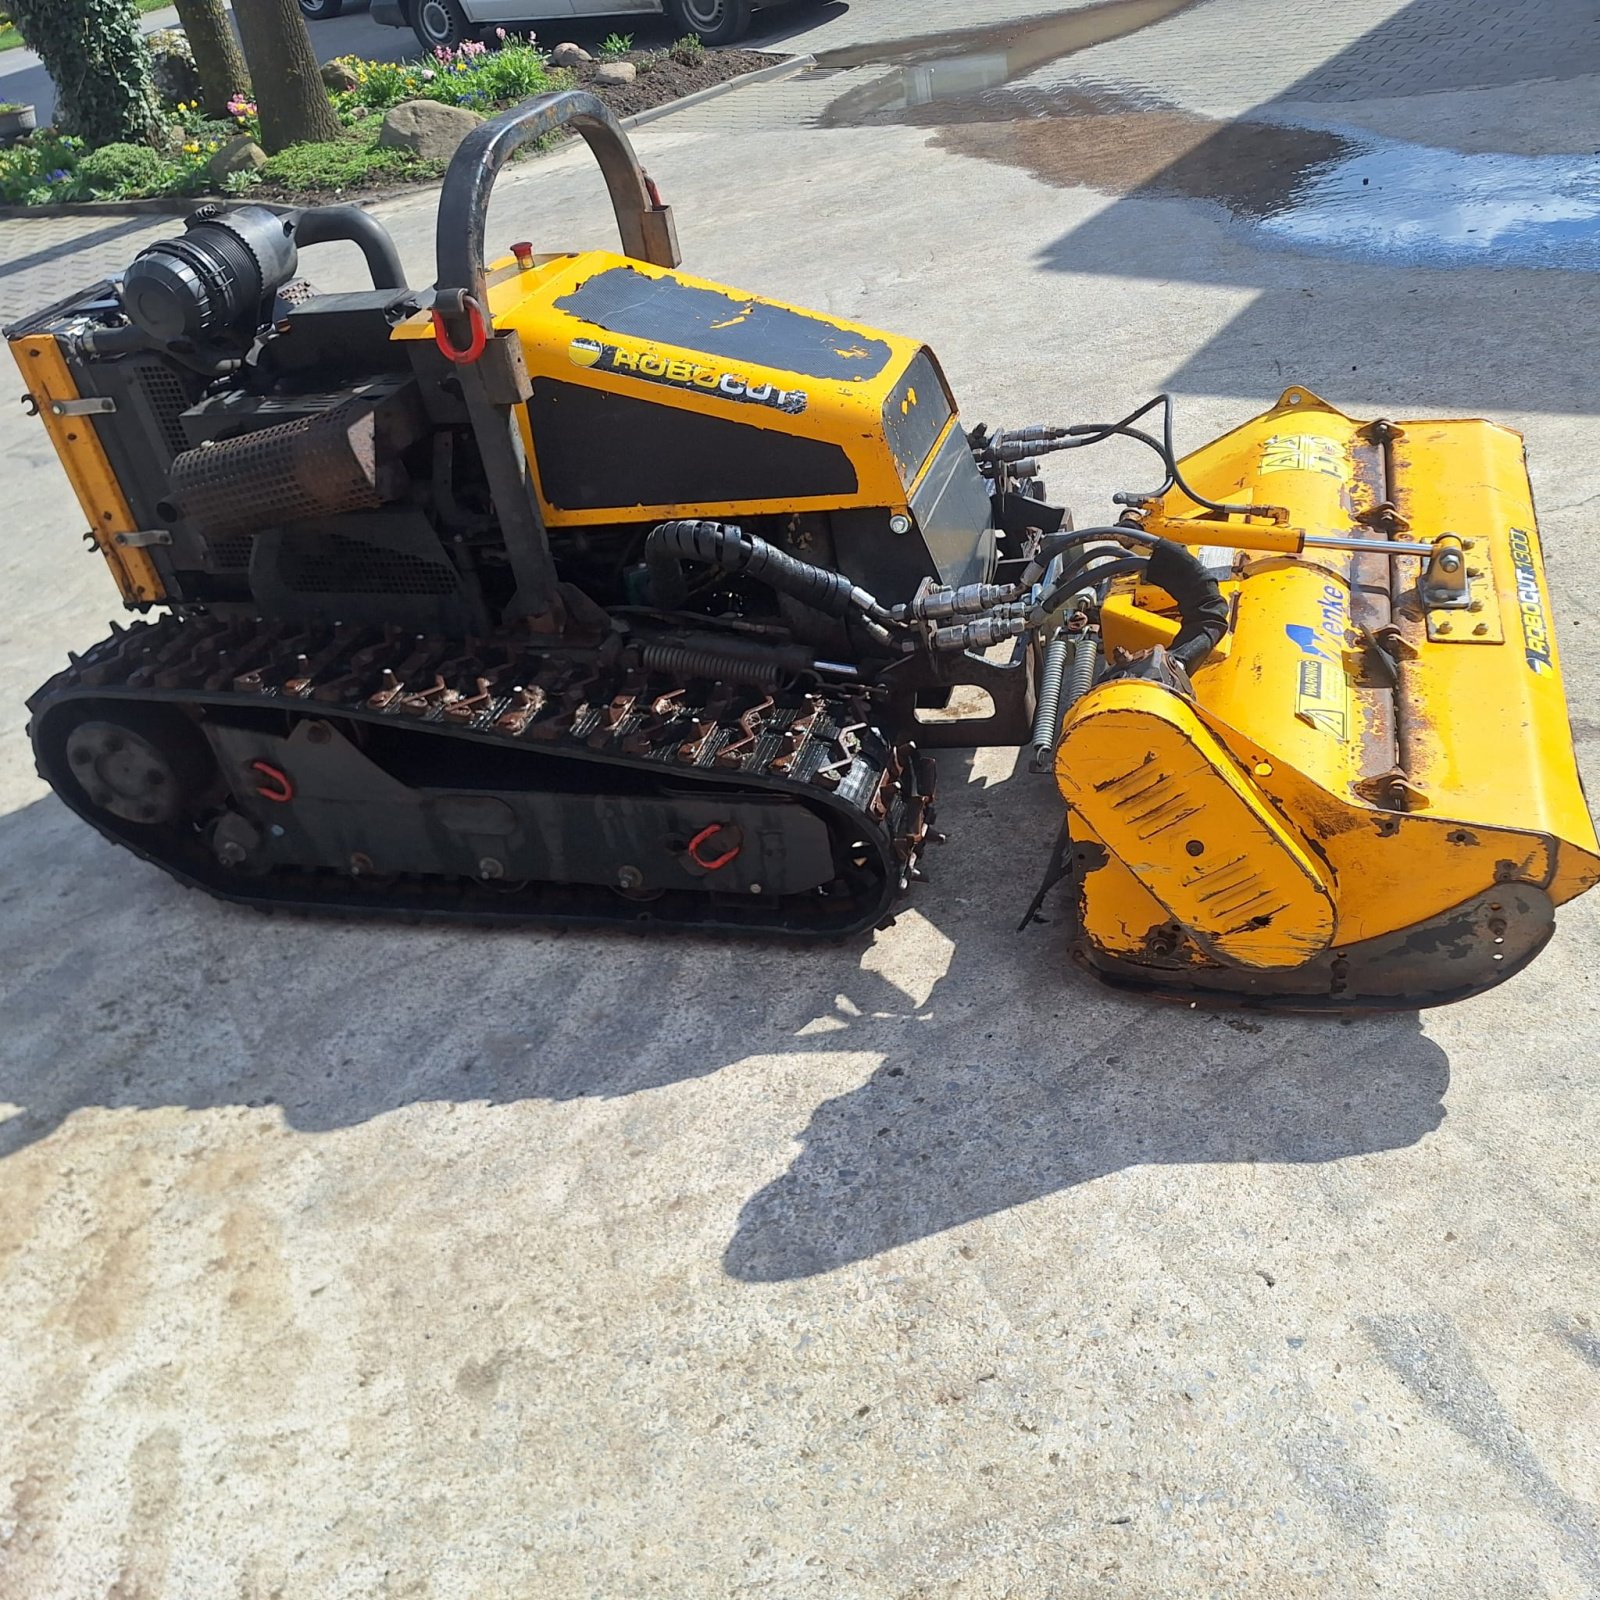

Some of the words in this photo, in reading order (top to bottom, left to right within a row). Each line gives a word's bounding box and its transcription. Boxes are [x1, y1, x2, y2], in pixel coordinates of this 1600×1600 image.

[1304, 584, 1345, 664] Menke
[1516, 568, 1548, 654] ROBOCUT
[1304, 660, 1319, 696] WARNING
